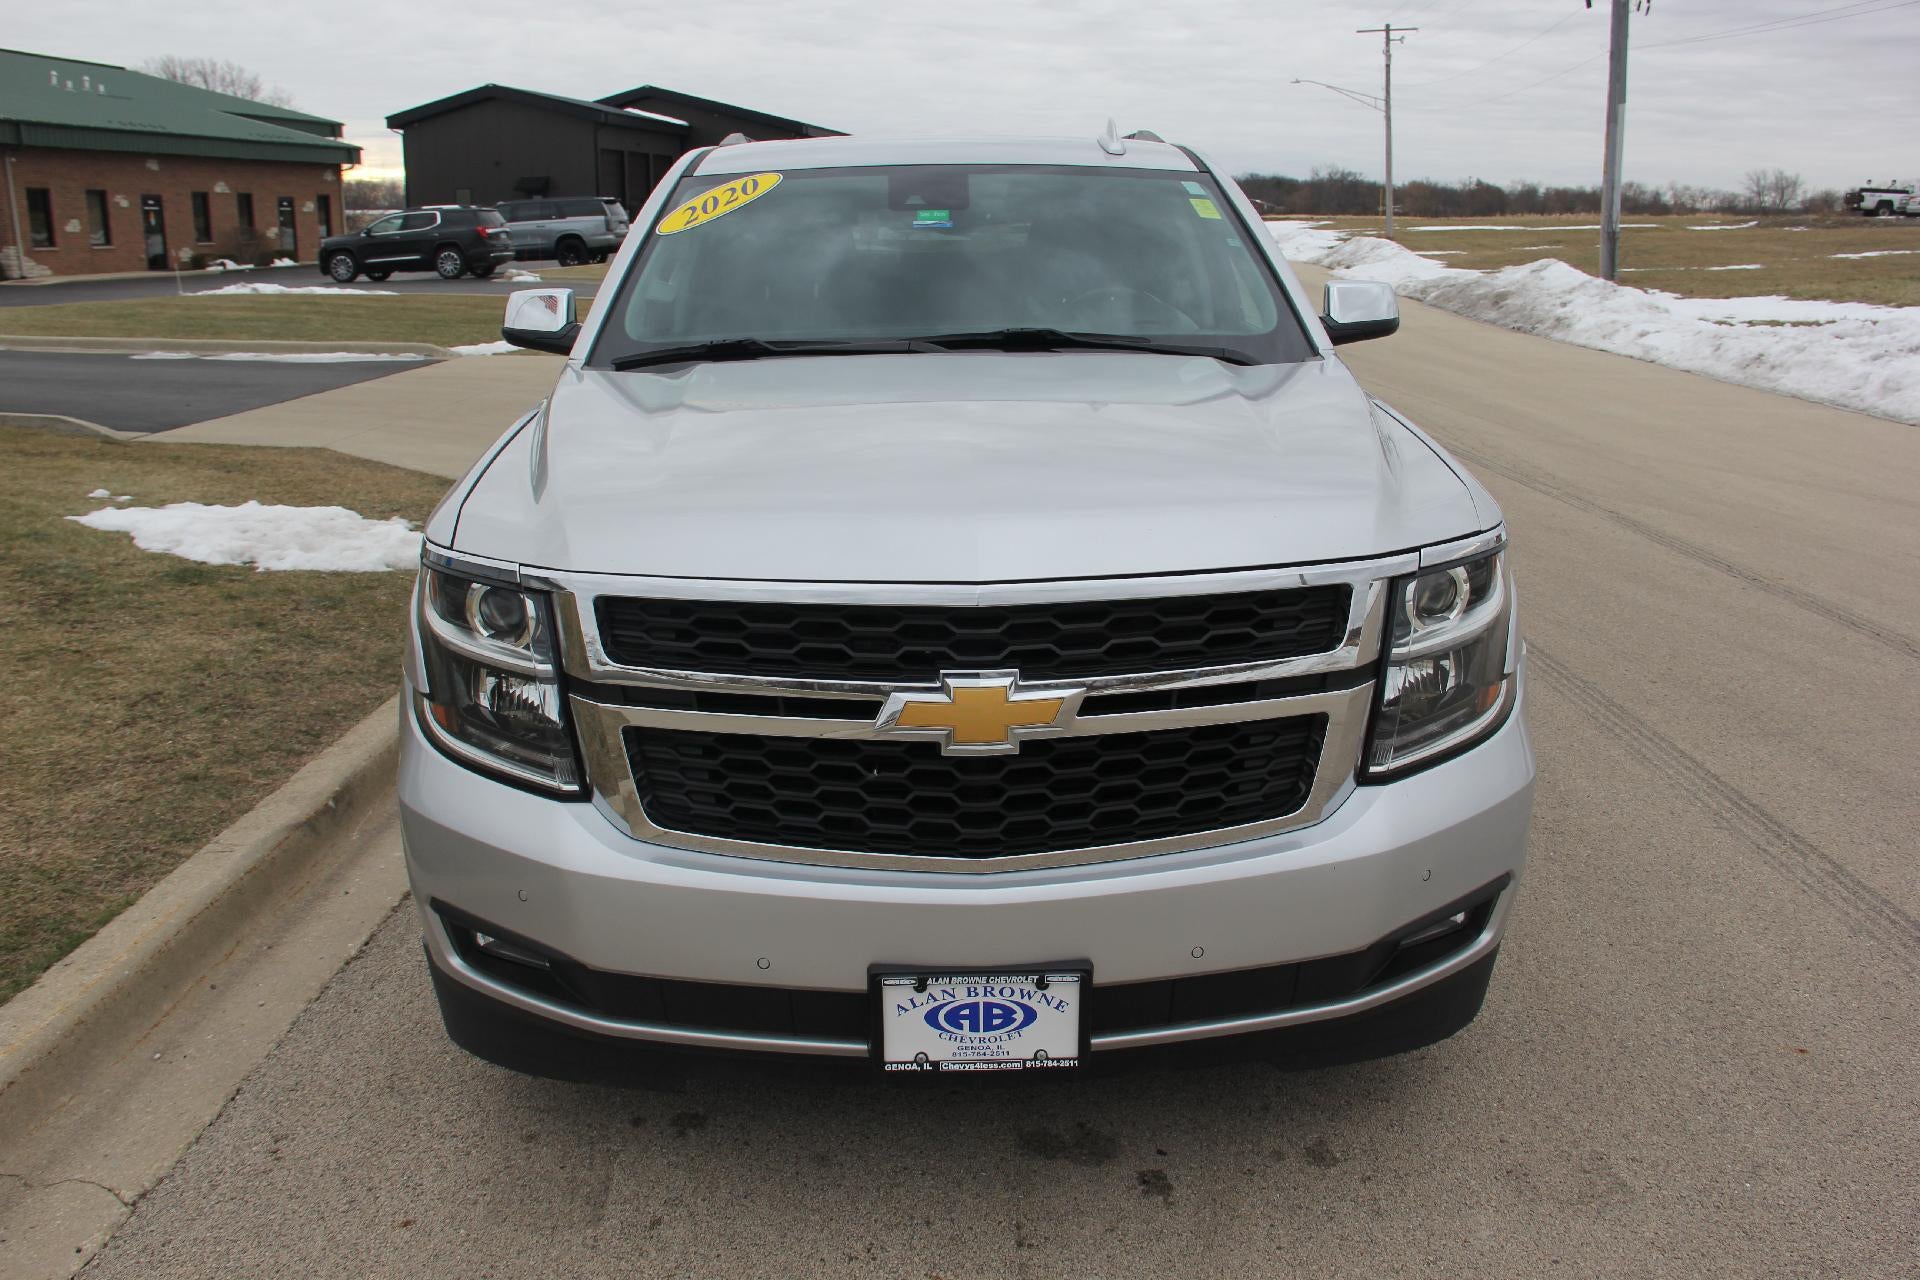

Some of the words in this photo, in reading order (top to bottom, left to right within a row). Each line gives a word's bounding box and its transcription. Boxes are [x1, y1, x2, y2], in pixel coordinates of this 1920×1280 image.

[682, 178, 759, 226] 2020
[926, 976, 949, 985] ALAN
[951, 976, 987, 985] BROWNE
[989, 975, 1039, 984] CHEVROLET
[896, 987, 956, 1017] ALAN
[966, 985, 1069, 1013] BROWNE
[938, 1029, 1023, 1045] CHEVROLET
[884, 1063, 921, 1072] GENOA,
[923, 1062, 933, 1070] IL
[942, 1062, 1020, 1070] Chevys4less.com
[1025, 1060, 1079, 1068] 815-784-2511
